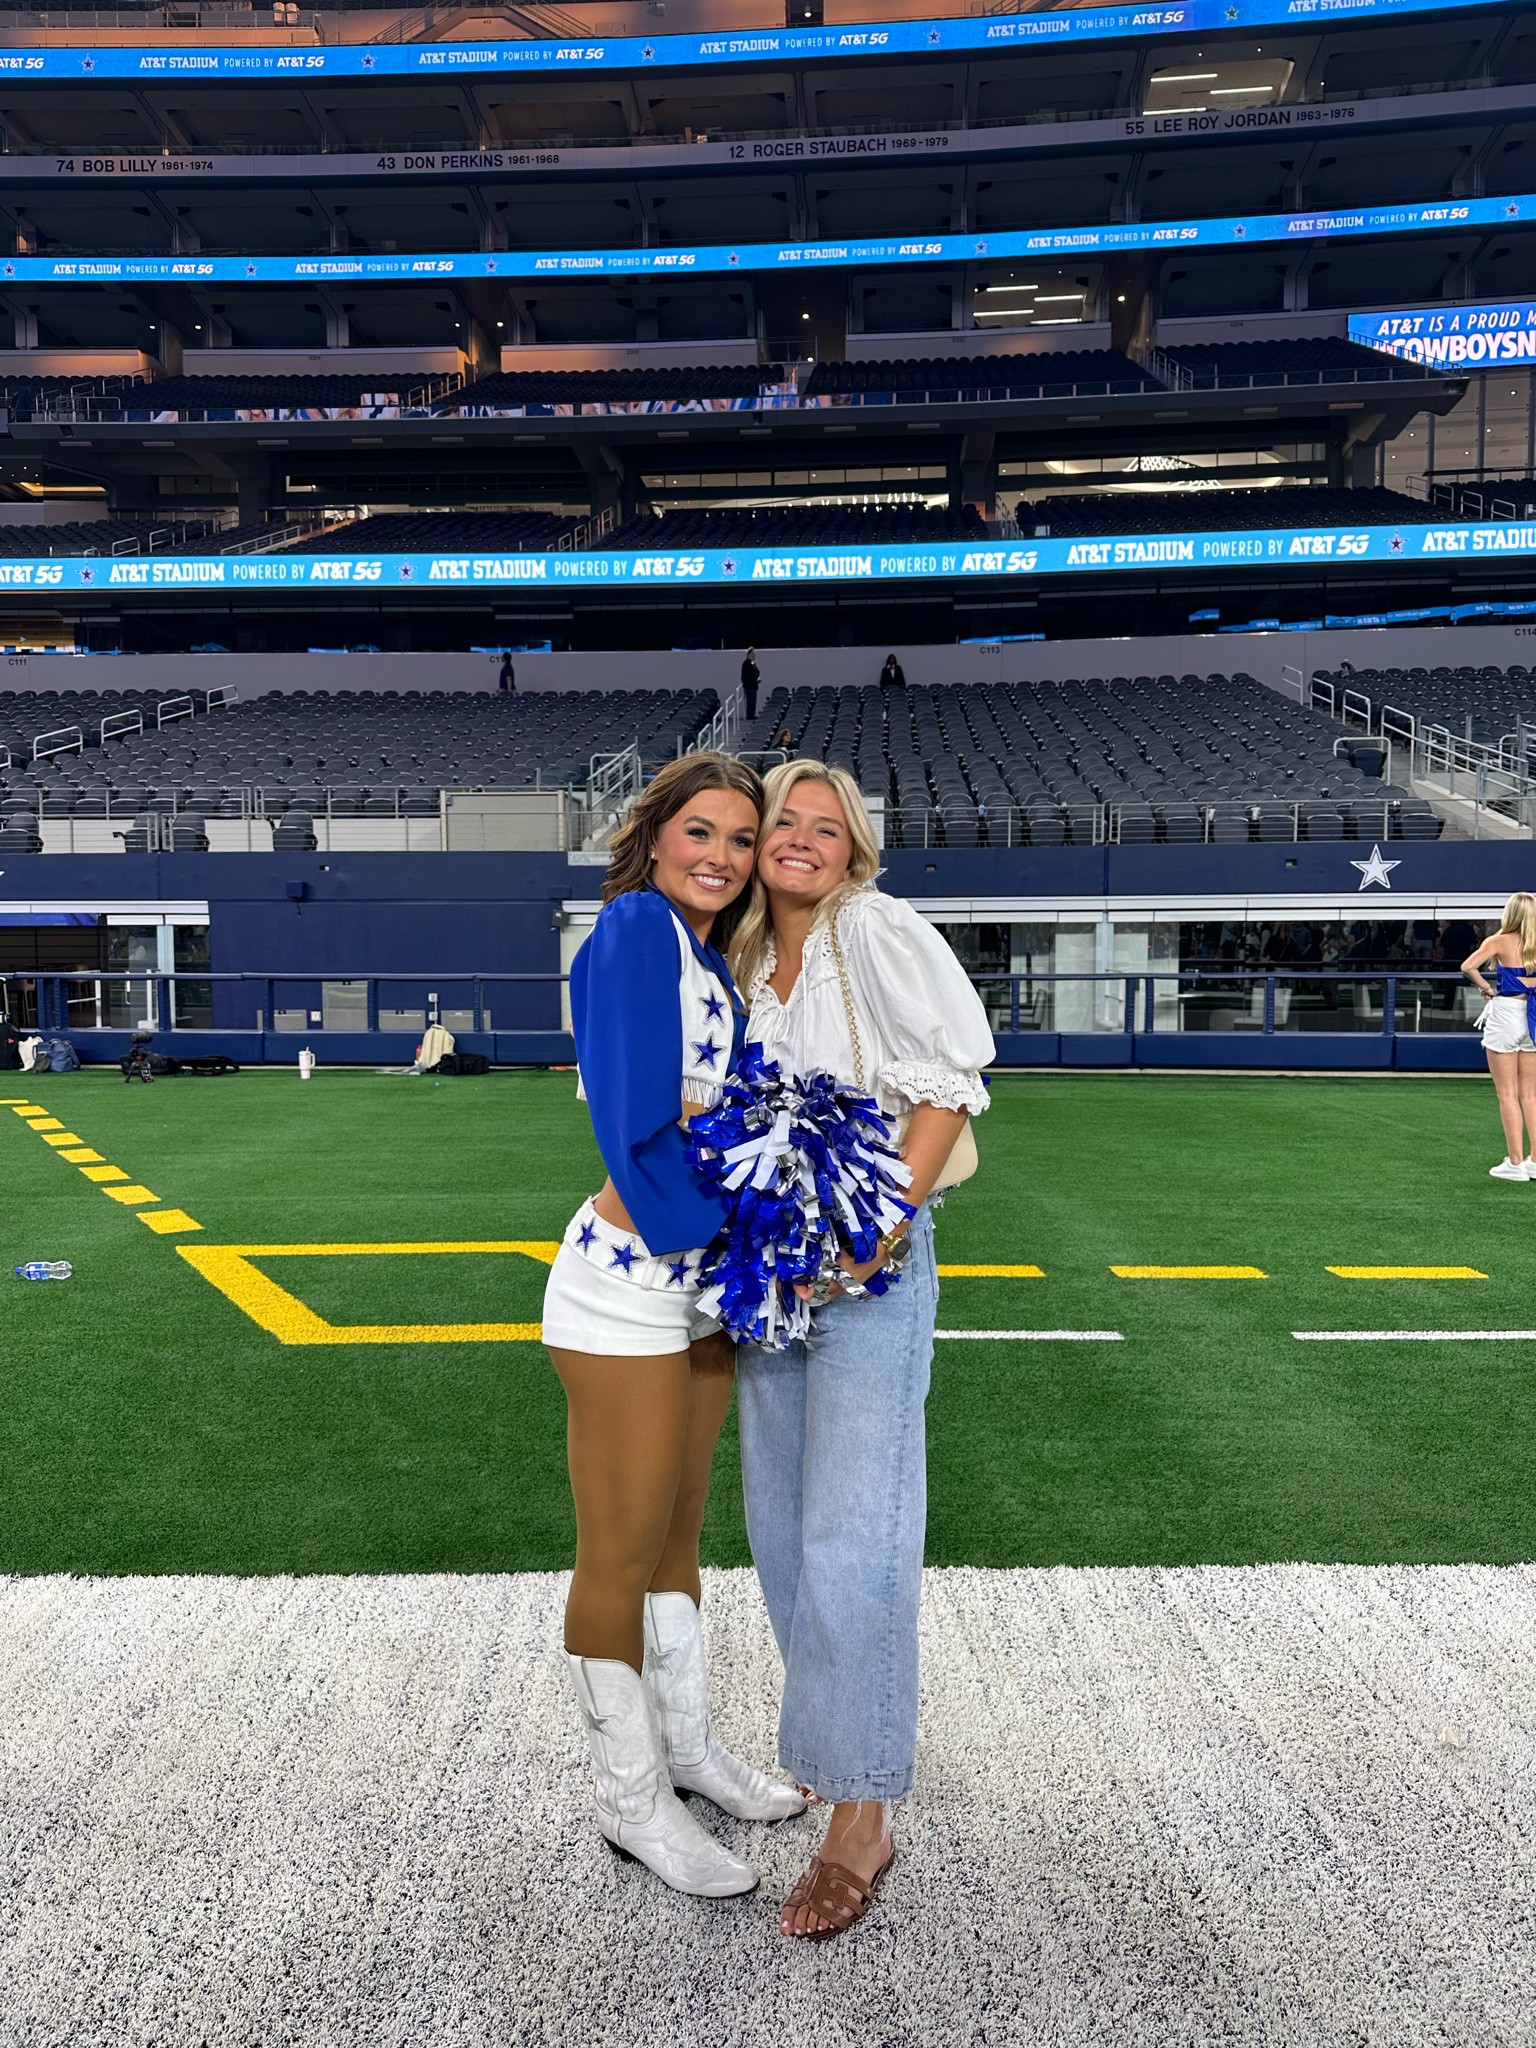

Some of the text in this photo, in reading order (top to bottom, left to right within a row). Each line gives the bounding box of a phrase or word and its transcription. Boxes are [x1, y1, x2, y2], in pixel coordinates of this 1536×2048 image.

[1289, 0, 1319, 13] AT&T
[987, 11, 1185, 37] AT&T STADIUM POWERED BY AT&T 5G
[700, 33, 889, 54] AT&T STADIUM POWERED BY AT&T 5G
[25, 57, 44, 69] 5G
[140, 57, 325, 69] AT&T STADIUM POWERED BY AT&T 5G
[419, 48, 604, 64] AT&T STADIUM POWERED BY AT&T 5G
[1125, 107, 1355, 134] 55 LEE ROY JORDAN 1963-1976
[729, 135, 948, 159] 12 ROGER STAUBACH 1969-1979
[56, 160, 213, 172] 74 BOB LILLY 1961-1974
[377, 154, 559, 170] 43 DON PERKINS 1961-1968
[1289, 206, 1469, 232] AT&T STADIUM POWERED BY AT&T 5G
[1027, 227, 1198, 248] AT&T STADIUM POWERED BY AT&T 5G
[779, 243, 942, 261] AT&T STADIUM POWERED BY AT&T 5G
[53, 263, 214, 274] AT&T STADIUM POWERED BY AT&T 5G
[296, 261, 454, 273] AT&T STADIUM POWERED BY AT&T 5G
[536, 254, 696, 269] AT&T STADIUM POWERED BY AT&T 5G
[1378, 317, 1424, 335] AT&T
[1428, 316, 1445, 332] IS
[1450, 314, 1460, 331] A
[1466, 311, 1521, 330] PROUD
[1068, 533, 1370, 565] AT&T STADIUM POWERED BY AT&T 5G
[1422, 531, 1470, 553] AT&T
[34, 565, 62, 583] 5G
[110, 561, 382, 583] AT&T STADIUM POWERED BY AT&T 5G
[430, 556, 705, 579] AT&T STADIUM POWERED BY AT&T 5G
[753, 551, 1038, 579] AT&T STADIUM POWERED BY AT&T 5G
[979, 646, 1000, 654] C113
[8, 658, 27, 666] C111
